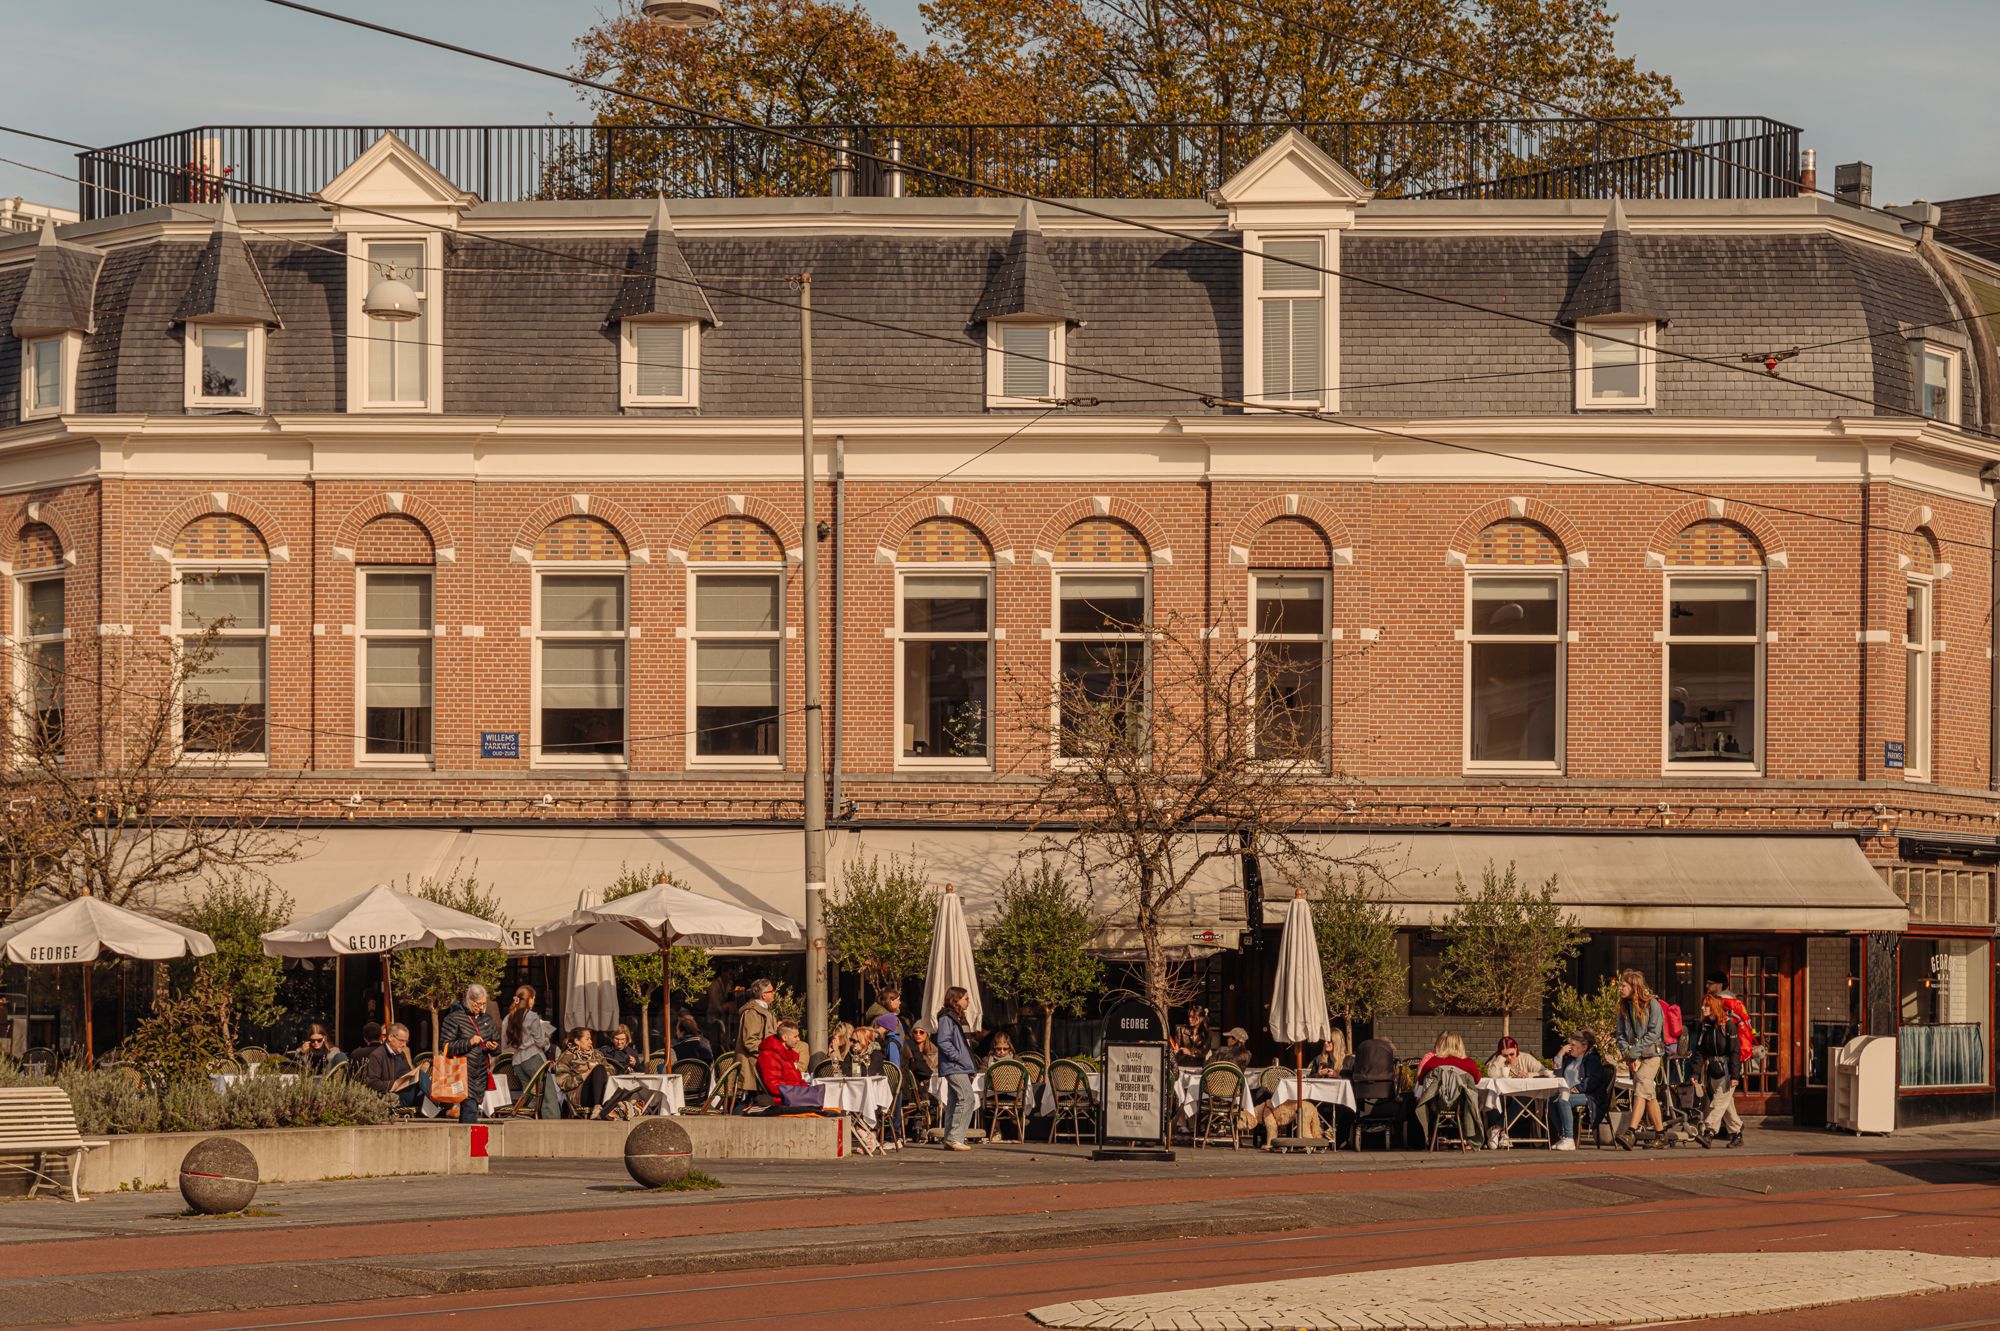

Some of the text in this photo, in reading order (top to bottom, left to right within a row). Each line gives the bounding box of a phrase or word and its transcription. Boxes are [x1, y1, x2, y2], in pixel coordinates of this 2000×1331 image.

[485, 734, 515, 742] WILLEMS
[484, 742, 516, 750] PARKWEG
[30, 945, 78, 960] GEORGE
[1120, 1018, 1149, 1030] GEORGE
[1121, 1064, 1142, 1074] SUMMER
[1143, 1065, 1153, 1074] YOU
[1119, 1073, 1151, 1083] WILL ALWAYS
[1114, 1082, 1154, 1093] REMEMBER WITH
[1119, 1092, 1149, 1102] PEOPLE YOU
[1117, 1101, 1151, 1111] NEVER FORGET
